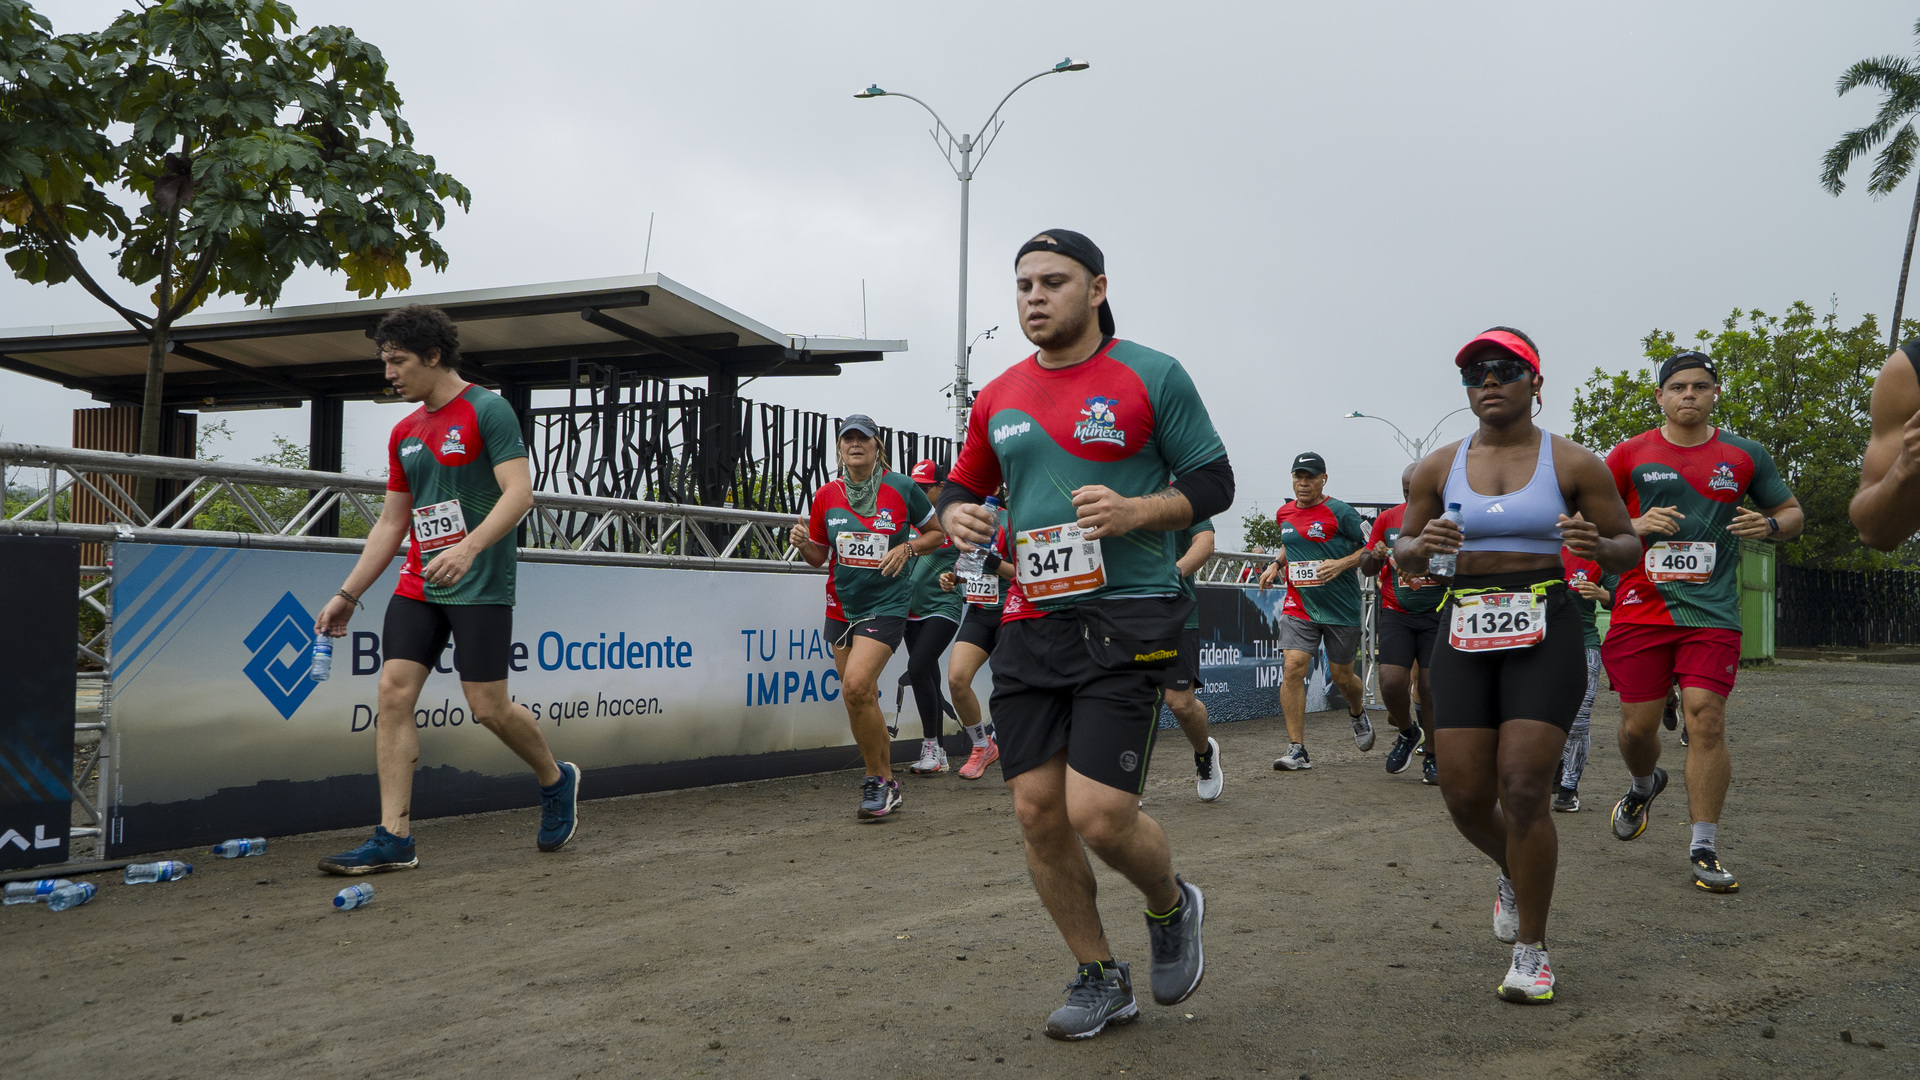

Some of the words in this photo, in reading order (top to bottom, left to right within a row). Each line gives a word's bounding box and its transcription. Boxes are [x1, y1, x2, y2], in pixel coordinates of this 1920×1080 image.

[1073, 423, 1125, 441] Muñeca
[416, 516, 452, 539] 1379
[848, 543, 874, 557] 284
[1027, 546, 1073, 577] 347
[1662, 554, 1698, 570] 460
[1295, 569, 1314, 579] 195
[967, 581, 991, 595] 2072
[1466, 611, 1530, 634] 1326
[537, 630, 693, 671] Occidente
[741, 629, 776, 662] TU
[1199, 642, 1240, 666] cidente
[1253, 640, 1268, 660] TU
[1204, 678, 1230, 694] hacen.
[414, 699, 464, 728] ado
[549, 700, 589, 727] que
[596, 691, 663, 718] hacen.
